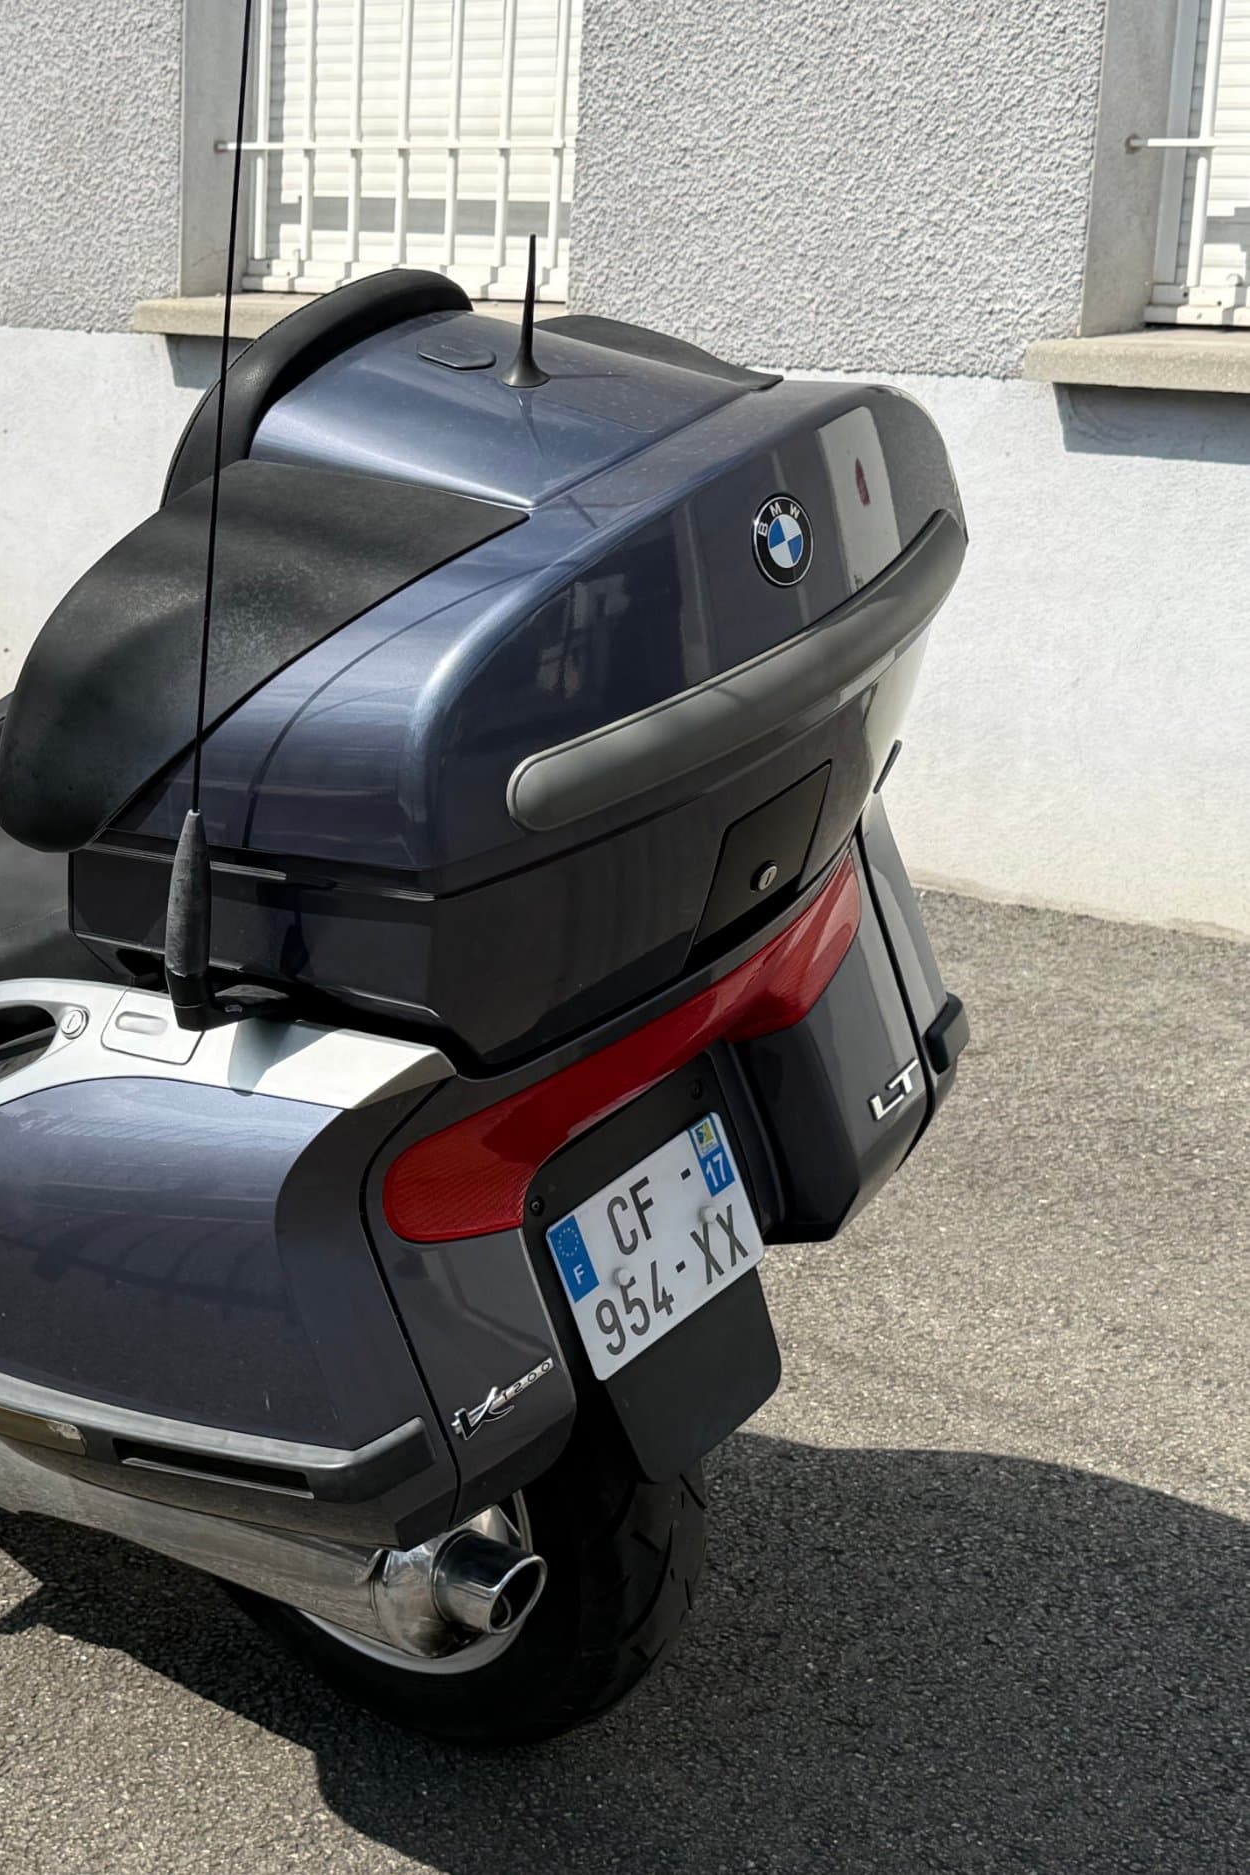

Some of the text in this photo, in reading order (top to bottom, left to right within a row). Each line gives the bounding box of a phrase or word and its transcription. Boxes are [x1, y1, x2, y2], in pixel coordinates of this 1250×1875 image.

[758, 502, 800, 537] BMW
[870, 1059, 918, 1120] LT
[705, 1152, 727, 1187] 17
[572, 1264, 585, 1285] F
[595, 1204, 748, 1356] 954-XX
